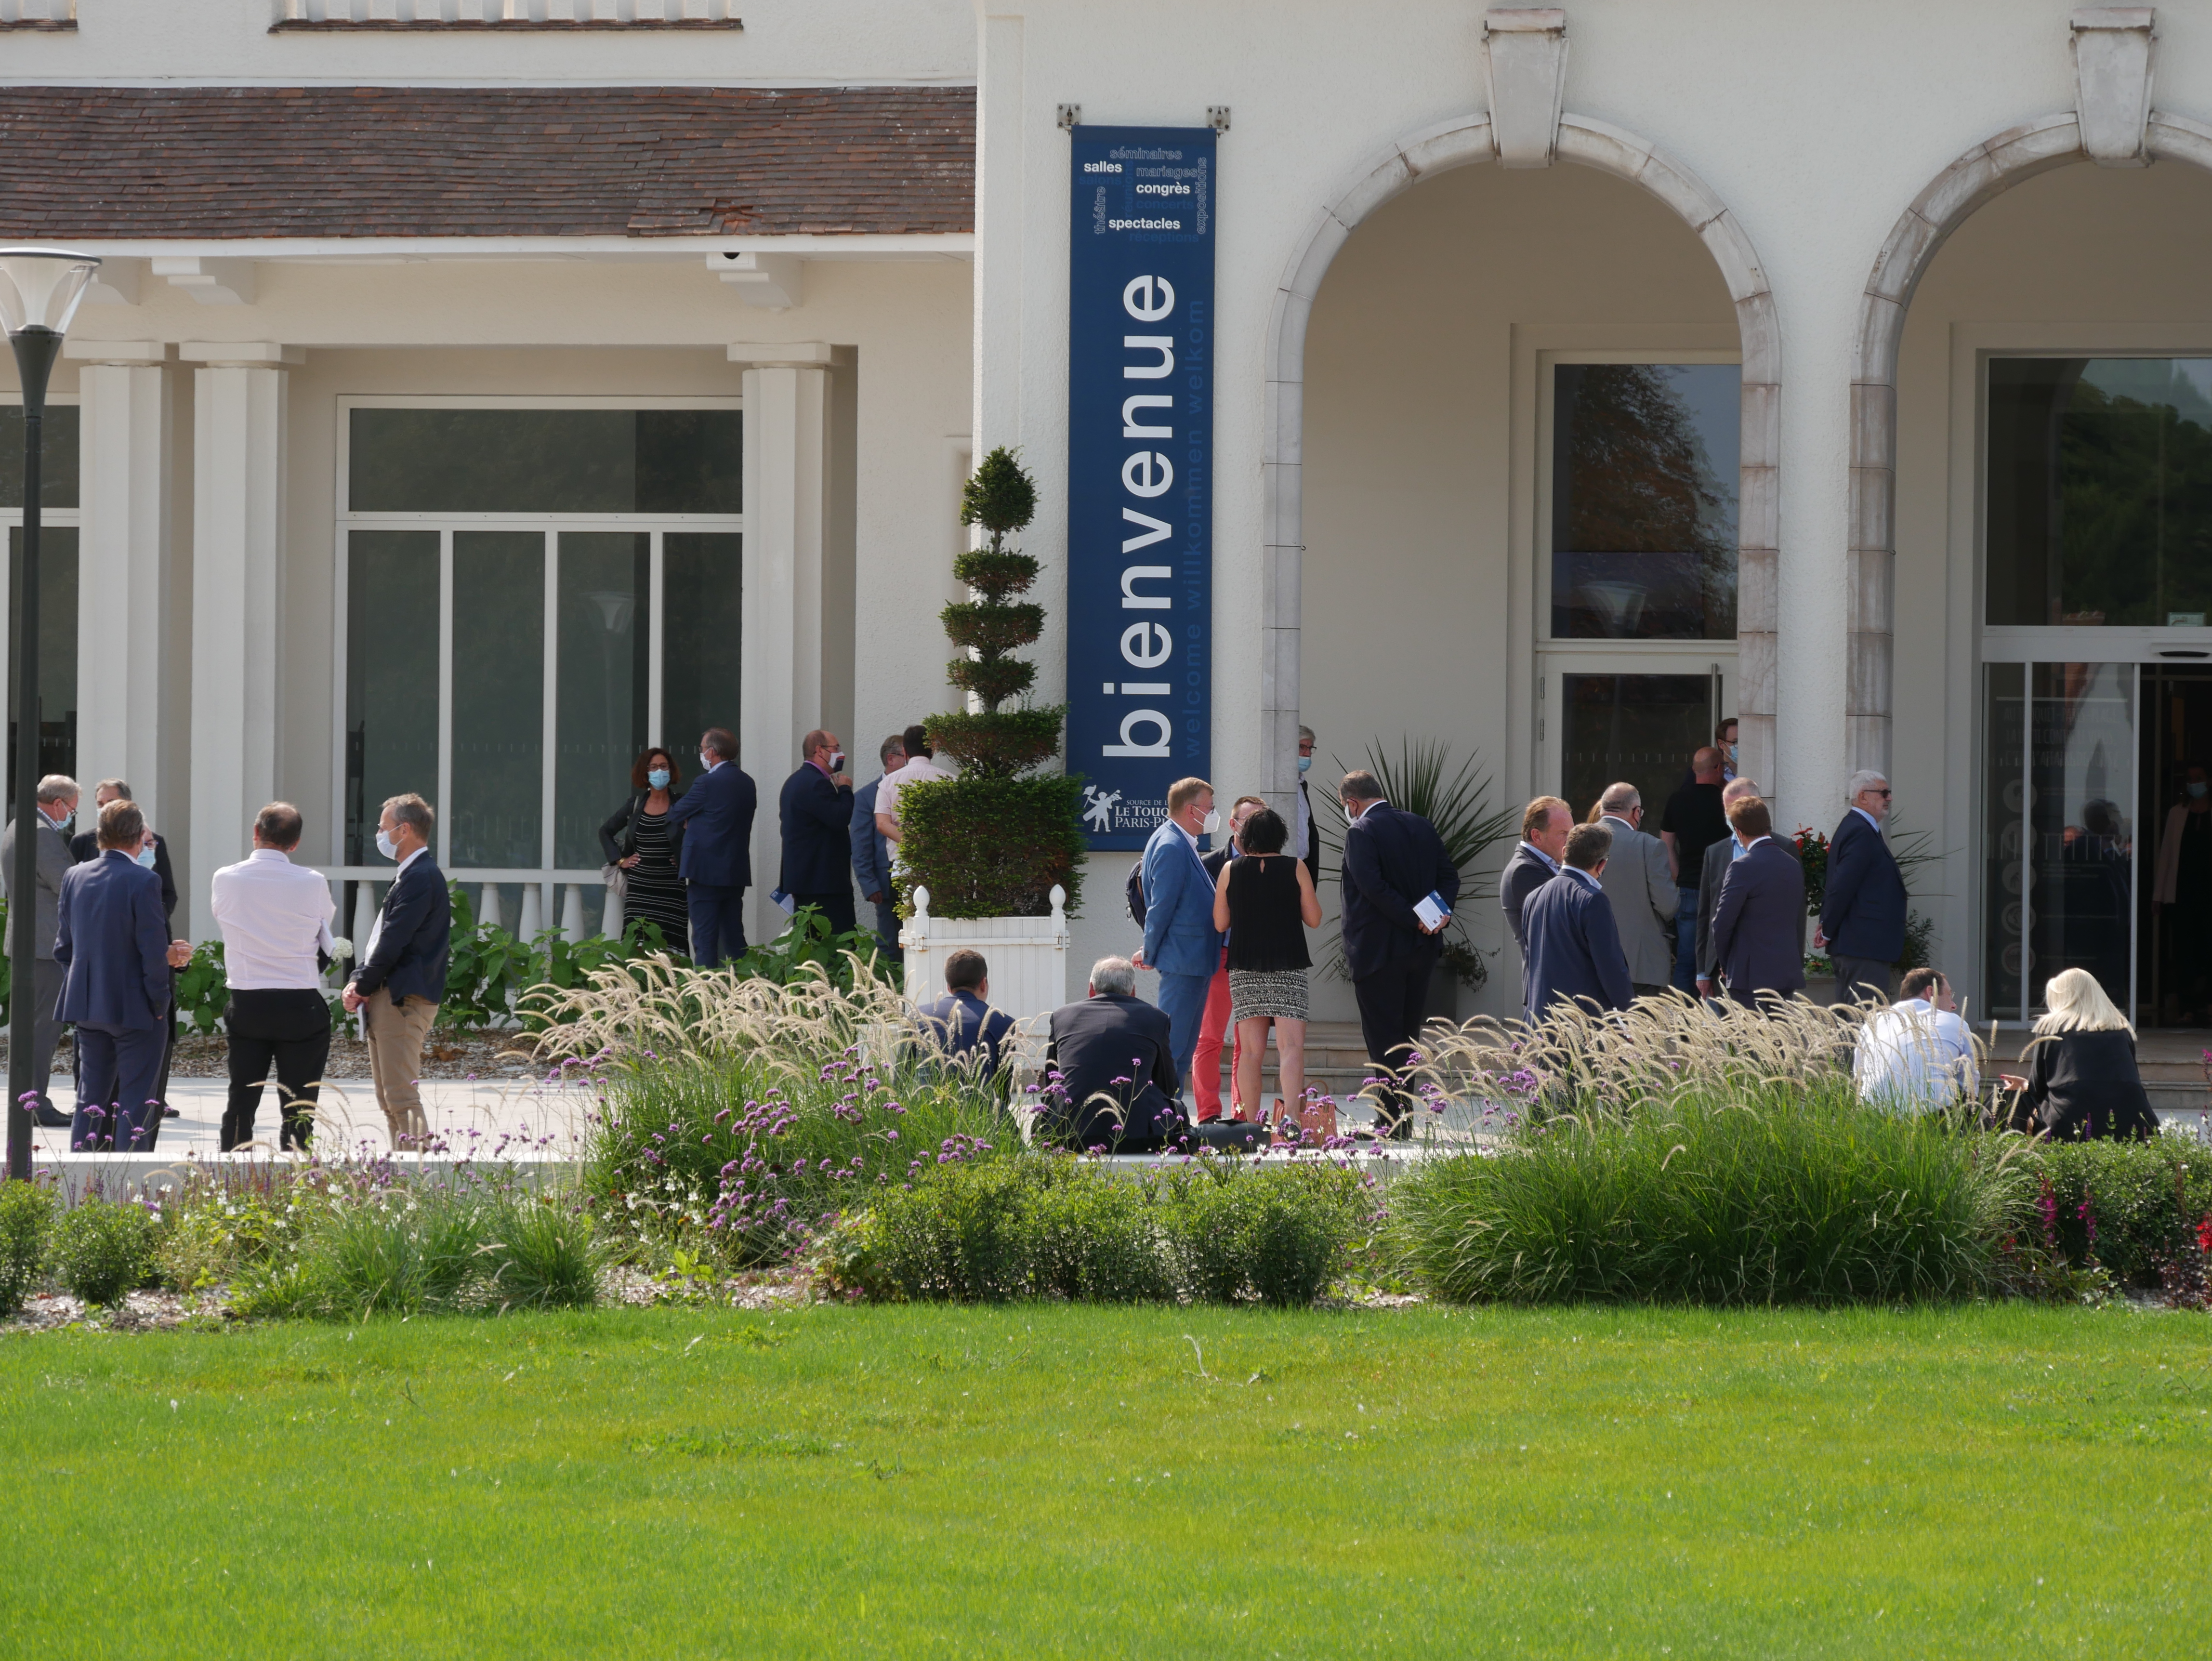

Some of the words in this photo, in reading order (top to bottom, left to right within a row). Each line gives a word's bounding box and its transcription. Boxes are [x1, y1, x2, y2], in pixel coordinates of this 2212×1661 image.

[1109, 146, 1182, 159] séminaires
[1084, 160, 1122, 172] salles
[1136, 165, 1198, 180] mariages
[1079, 174, 1122, 185] salons
[1122, 160, 1133, 218] réunions
[1136, 181, 1190, 196] congrès
[1195, 157, 1209, 234] expositions
[1093, 186, 1106, 235] théâtre
[1136, 199, 1194, 210] concerts
[1108, 217, 1181, 231] spectacles
[1129, 230, 1199, 244] réceptions
[1185, 300, 1203, 415] welkom
[1102, 275, 1175, 757] bienvenue
[1183, 430, 1202, 610] willkommen
[1182, 624, 1201, 759] welcome
[1115, 806, 1130, 816] LE
